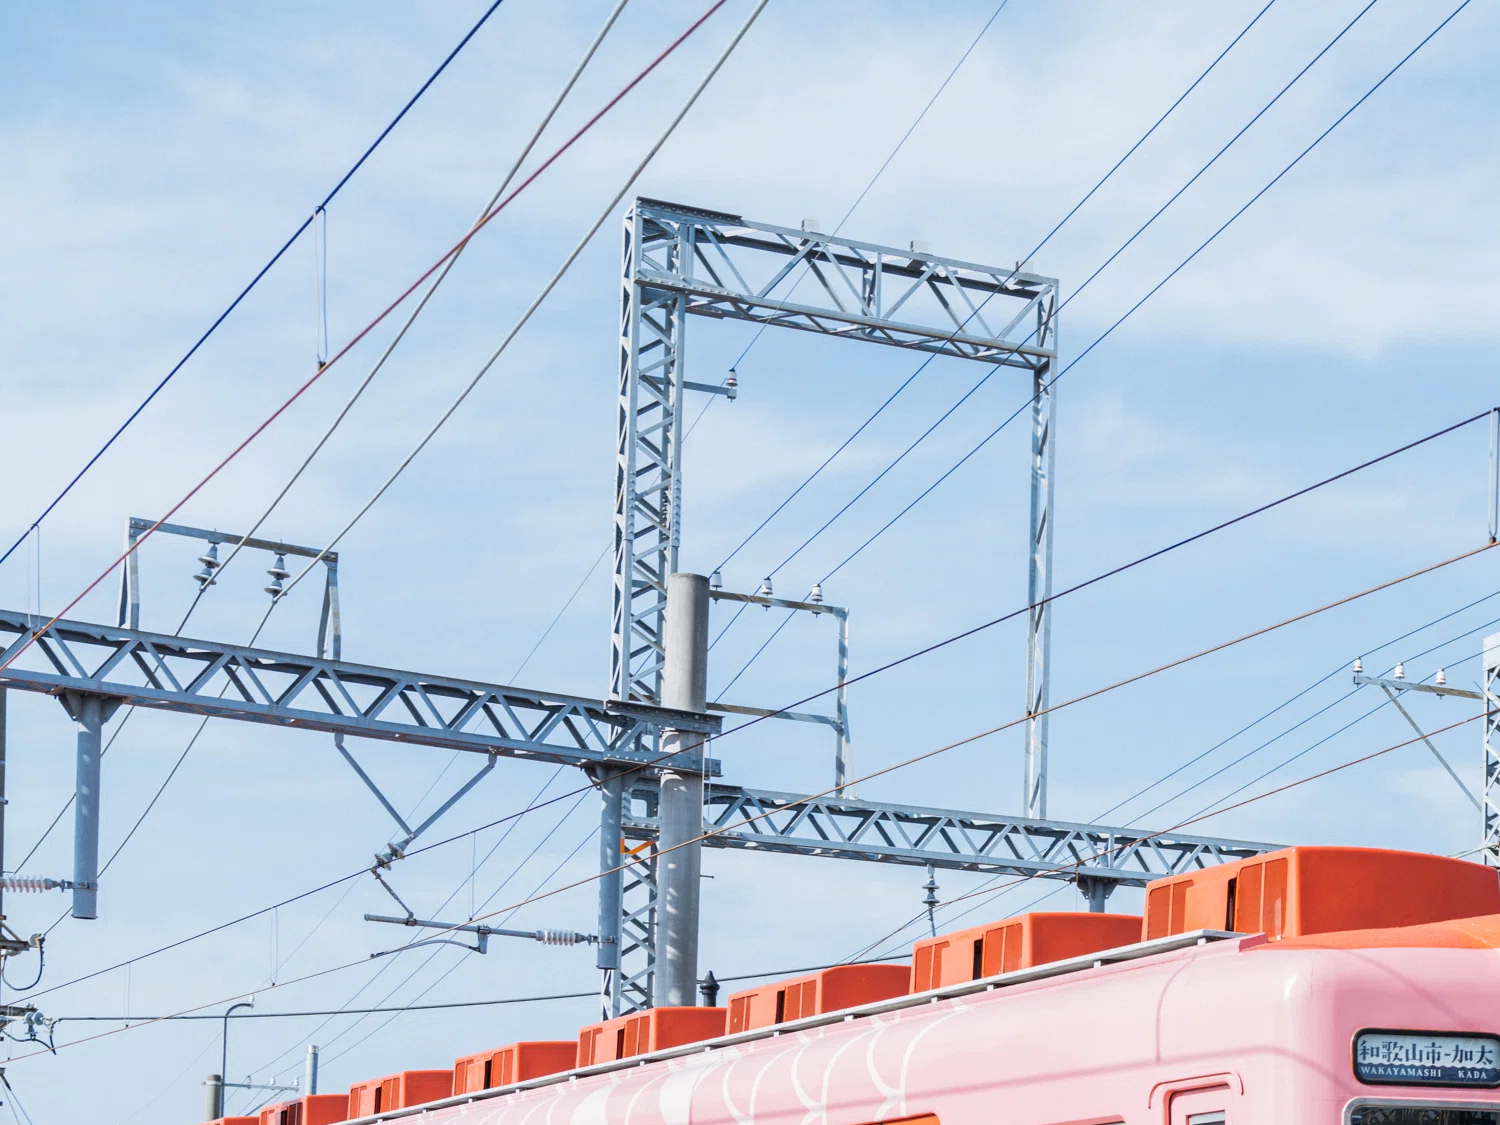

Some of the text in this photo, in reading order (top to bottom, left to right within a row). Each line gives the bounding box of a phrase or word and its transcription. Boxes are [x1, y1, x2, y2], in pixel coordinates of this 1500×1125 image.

[1358, 1040, 1494, 1066] 和歌山市-加太
[1360, 1066, 1488, 1080] WAKAYAMASHI KADA
